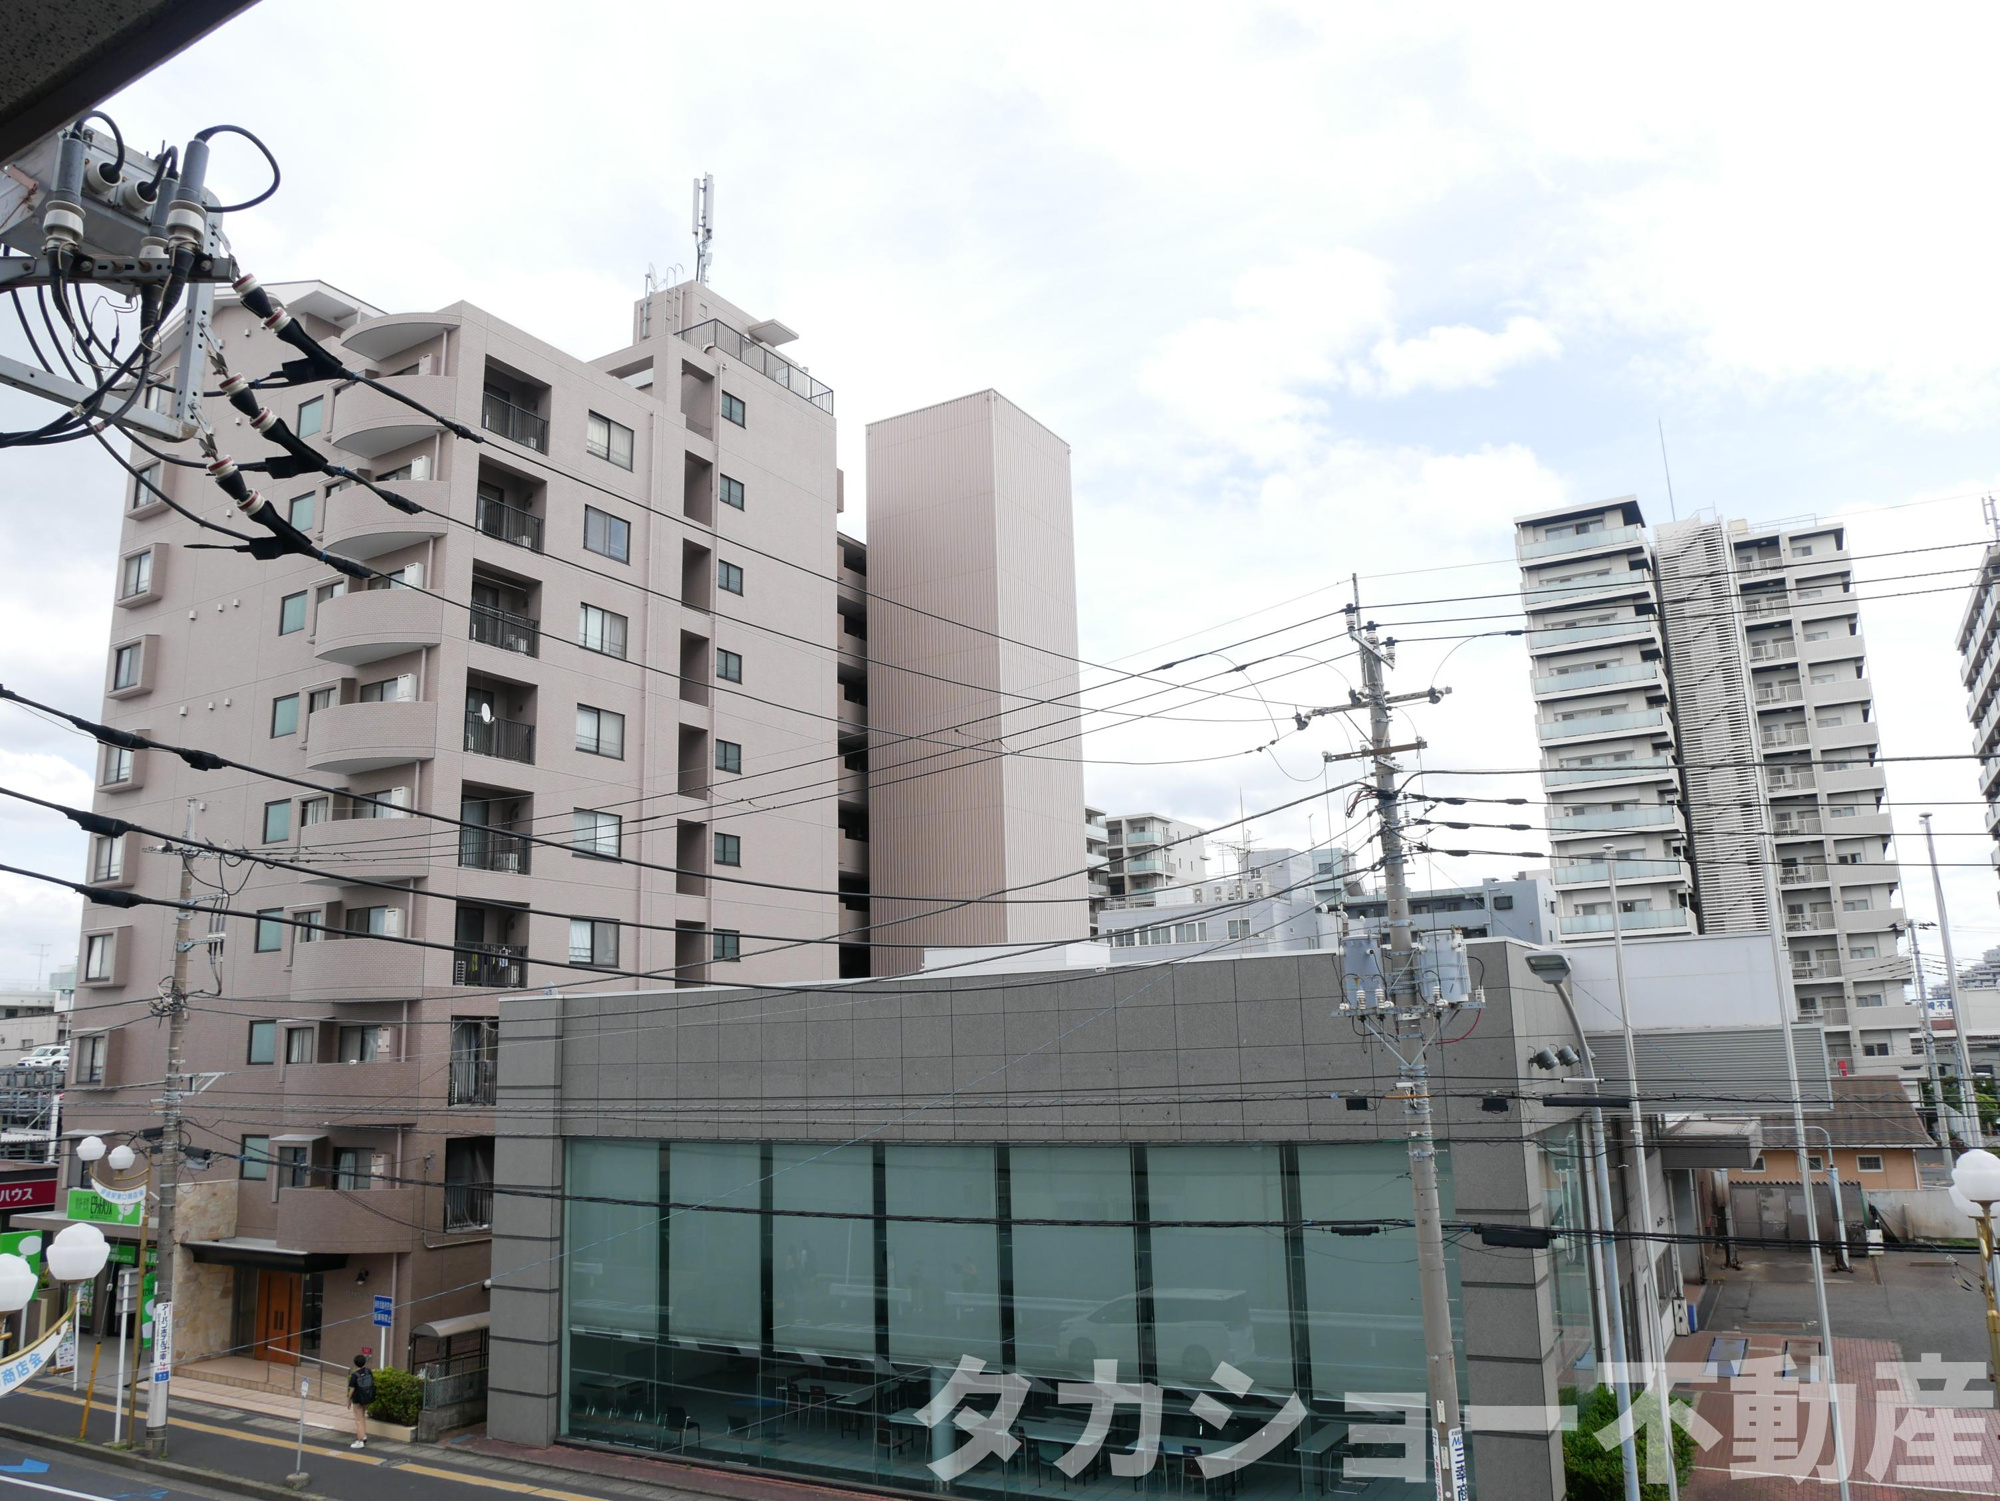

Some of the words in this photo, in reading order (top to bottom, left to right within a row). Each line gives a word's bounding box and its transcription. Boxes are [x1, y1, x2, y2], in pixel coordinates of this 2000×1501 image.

[0, 1187, 33, 1202] ハウス
[1, 1353, 44, 1386] 商店会
